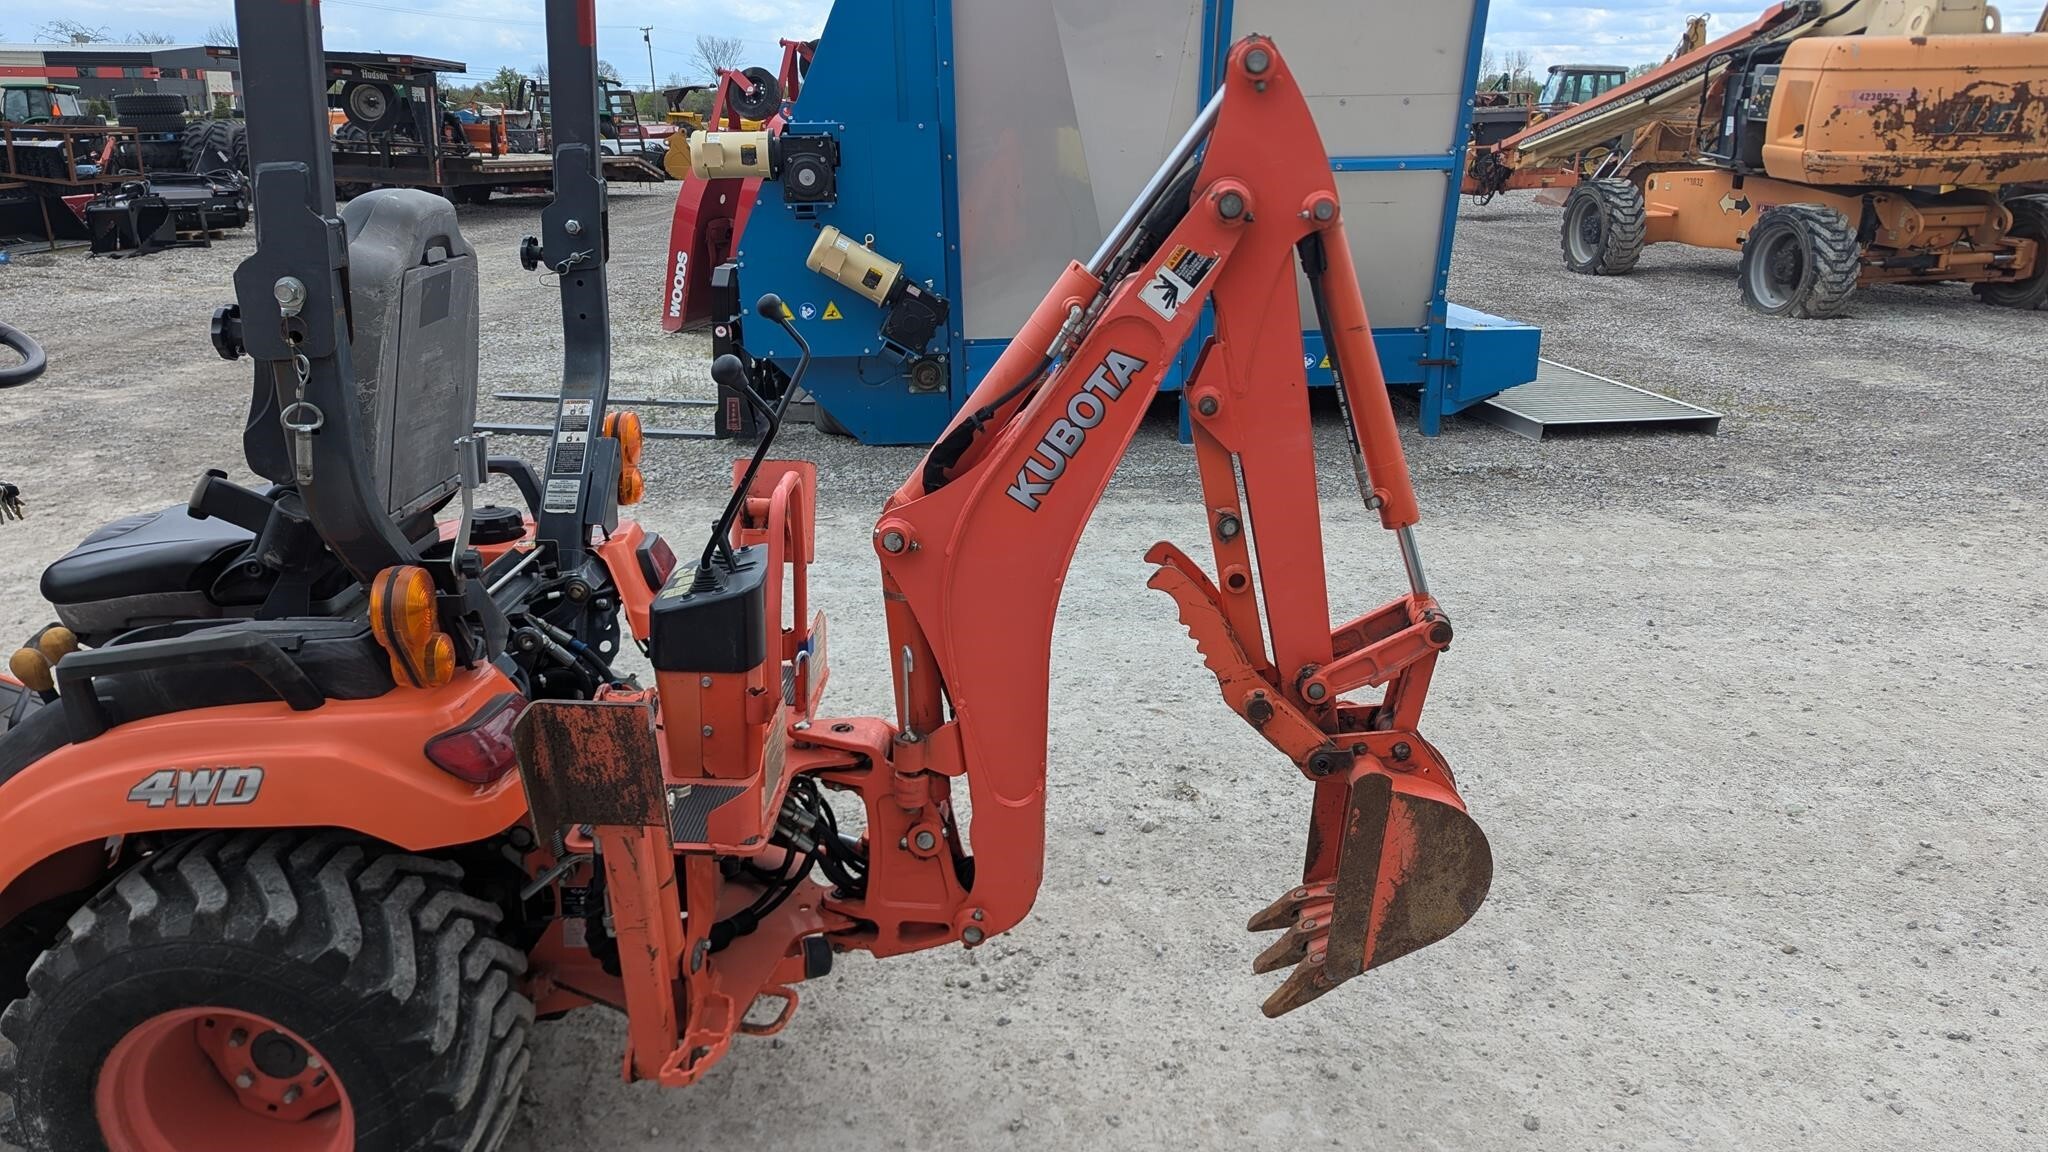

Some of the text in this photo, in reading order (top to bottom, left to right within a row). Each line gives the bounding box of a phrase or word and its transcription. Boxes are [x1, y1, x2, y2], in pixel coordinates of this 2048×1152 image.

[361, 69, 388, 80] Hudson
[670, 251, 688, 317] WOODS
[1005, 349, 1148, 512] KUBOTA
[127, 766, 264, 808] 4WD
